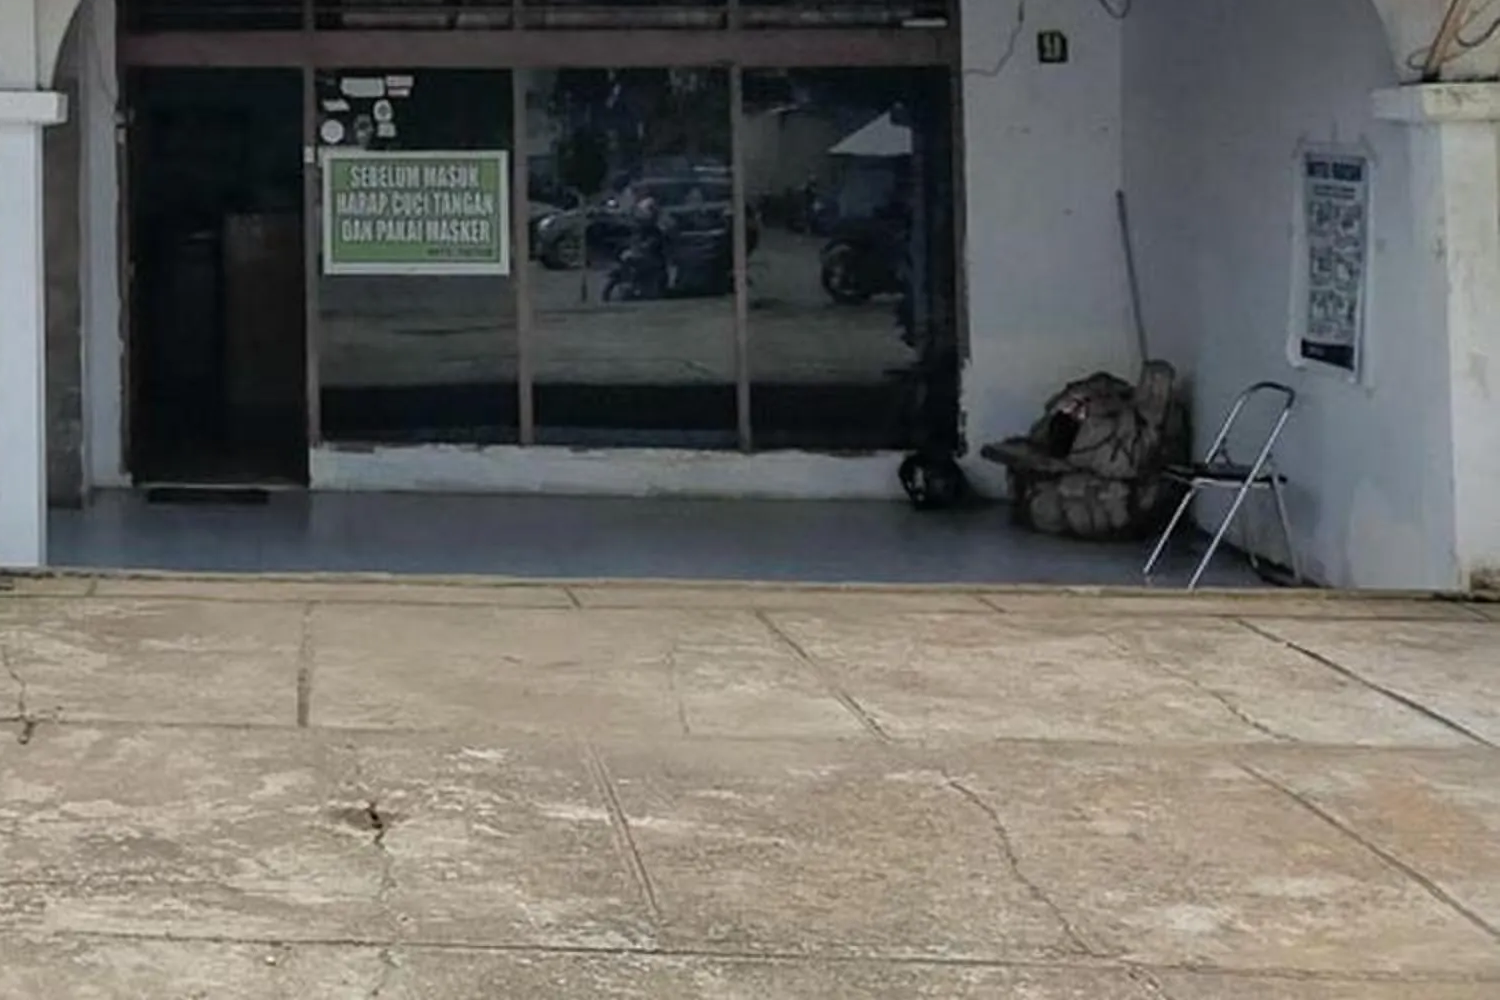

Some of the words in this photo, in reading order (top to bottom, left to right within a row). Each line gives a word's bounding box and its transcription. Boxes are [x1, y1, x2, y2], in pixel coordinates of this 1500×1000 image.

[350, 165, 420, 188] SEBELUM
[423, 165, 480, 188] MASUK
[391, 191, 429, 216] CUCI
[432, 191, 495, 216] TANGAN
[341, 219, 373, 242] DAN
[376, 219, 423, 242] PAKAI
[426, 219, 491, 243] MASKER
